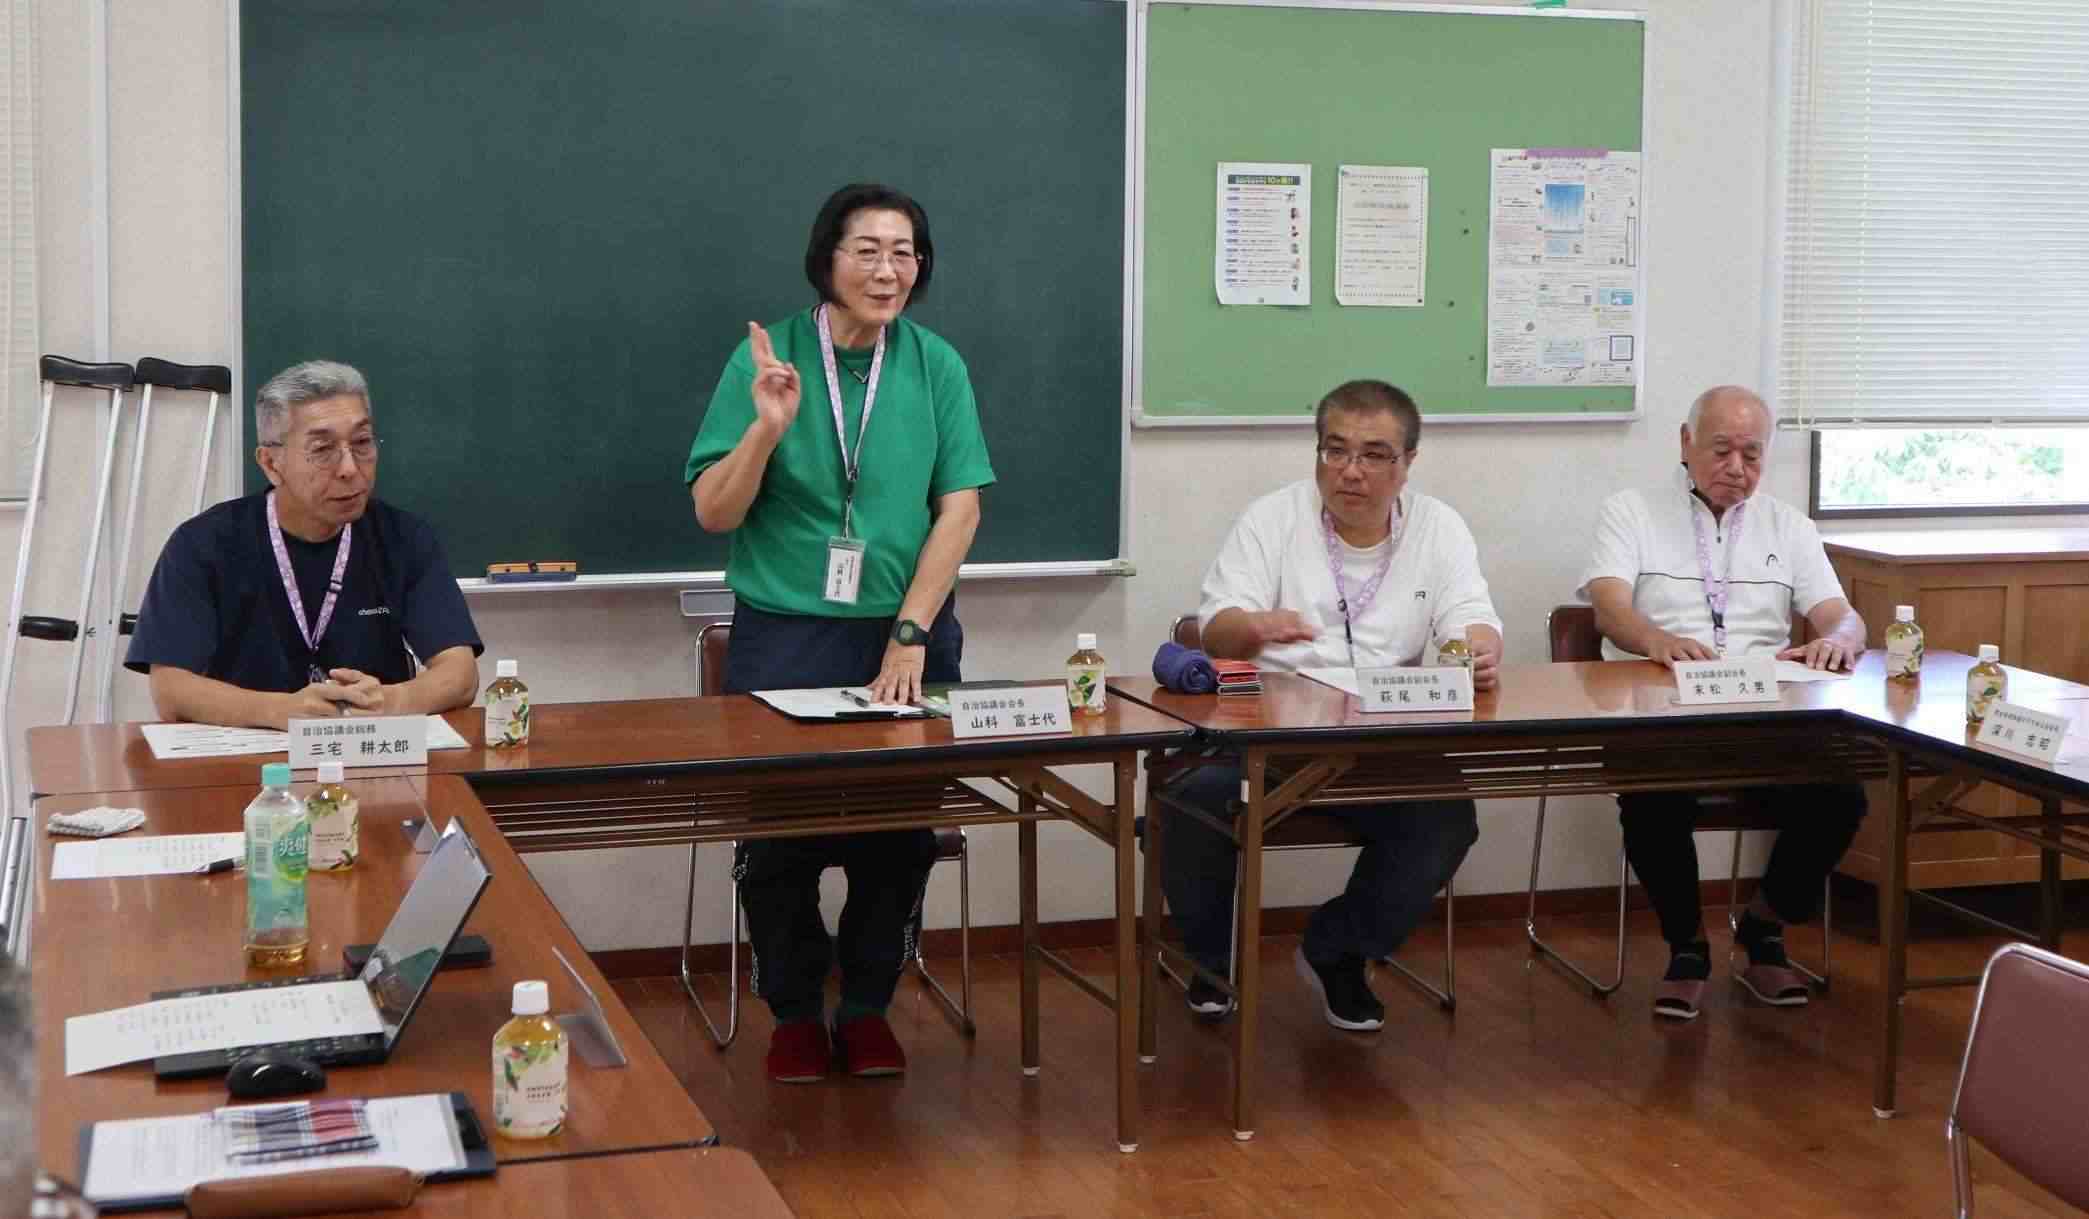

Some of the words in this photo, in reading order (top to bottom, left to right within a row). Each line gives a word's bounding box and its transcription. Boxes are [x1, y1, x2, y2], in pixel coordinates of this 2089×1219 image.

[970, 715, 999, 729] 山科
[1013, 712, 1057, 728] 富士代
[309, 741, 343, 756] 三宅
[360, 739, 409, 756] 耕太郎
